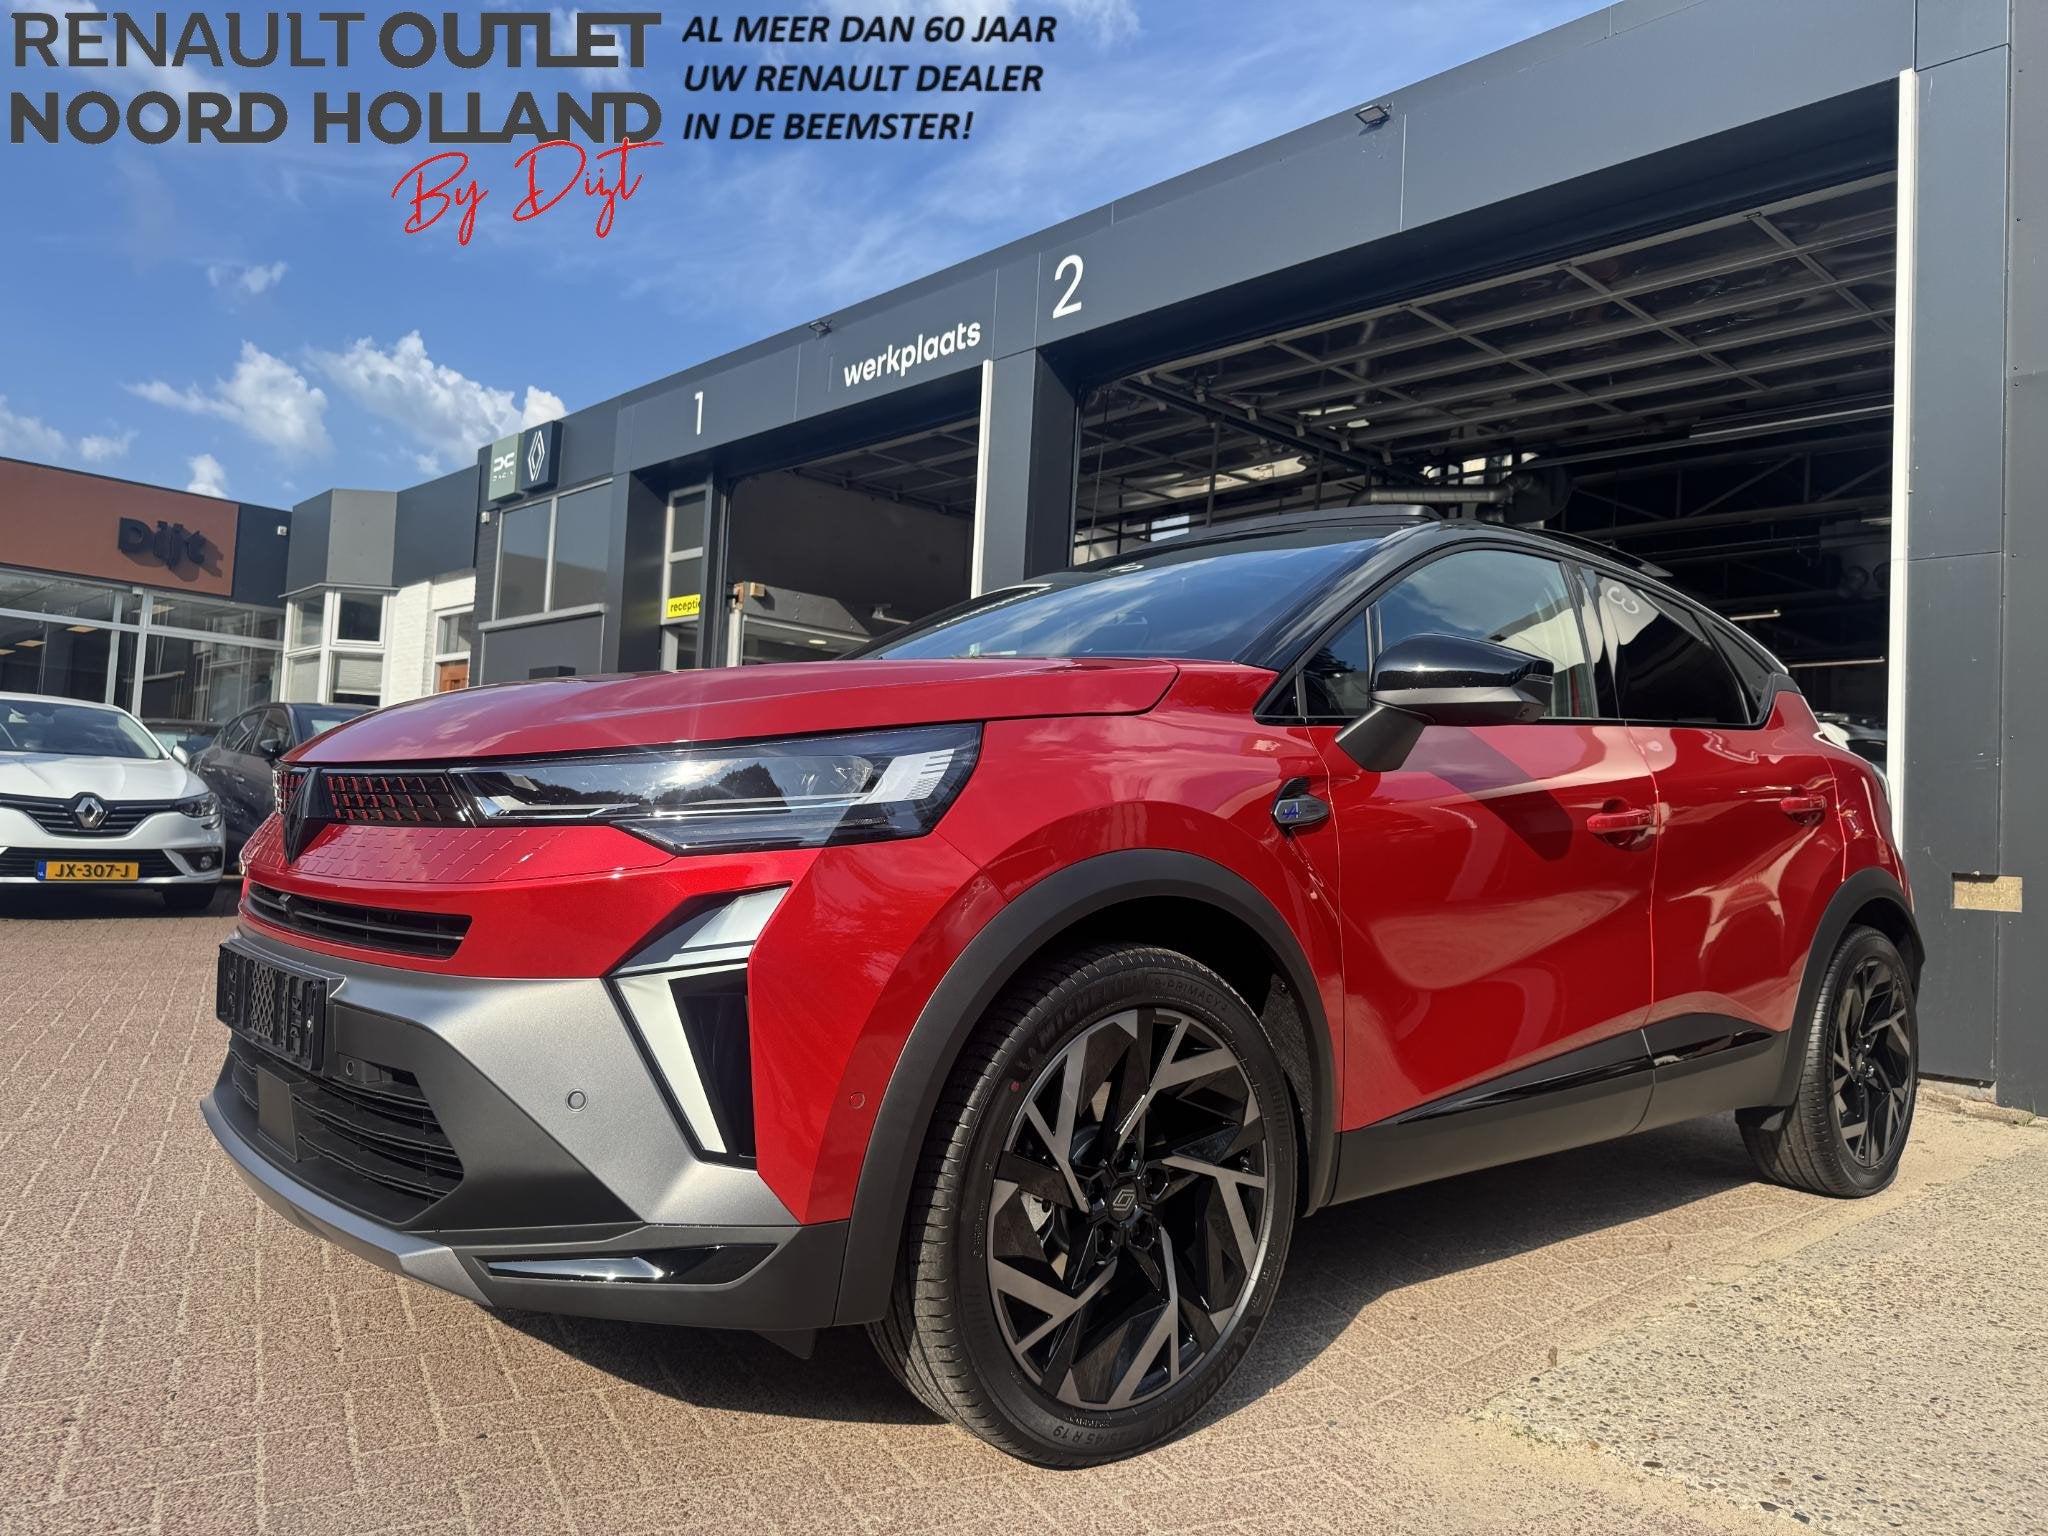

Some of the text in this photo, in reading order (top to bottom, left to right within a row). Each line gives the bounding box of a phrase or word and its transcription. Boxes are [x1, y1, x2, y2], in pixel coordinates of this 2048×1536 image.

[1052, 254, 1084, 319] 2
[843, 321, 981, 387] werkplaats
[695, 391, 704, 435] 1
[55, 864, 130, 878] JX-307-J
